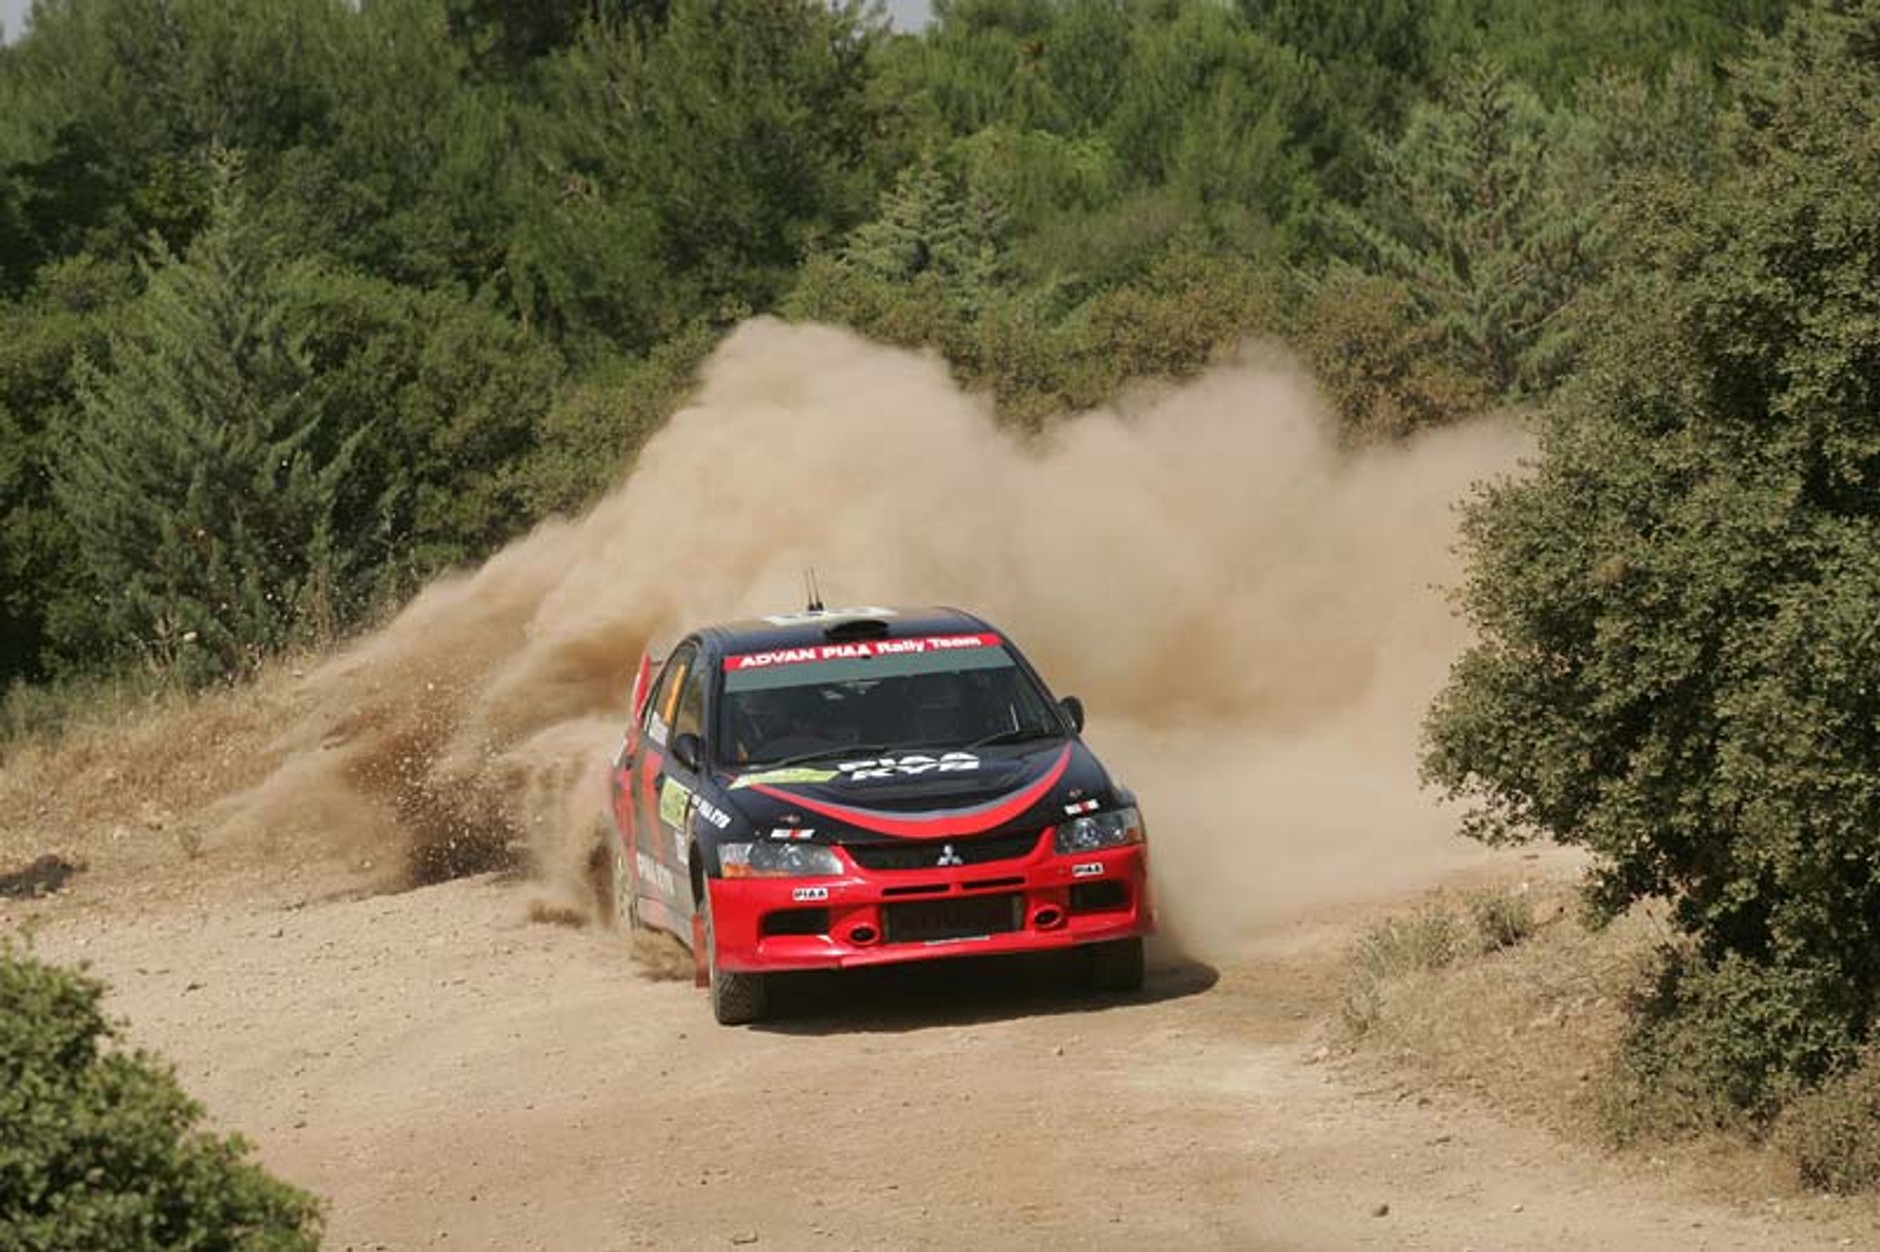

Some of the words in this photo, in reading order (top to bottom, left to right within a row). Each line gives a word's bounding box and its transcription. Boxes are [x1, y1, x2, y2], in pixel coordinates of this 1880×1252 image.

[739, 648, 816, 668] ADVAN
[822, 643, 872, 658] PIAA
[877, 639, 926, 656] Rally
[927, 635, 982, 649] Team
[794, 889, 826, 899] PIAA
